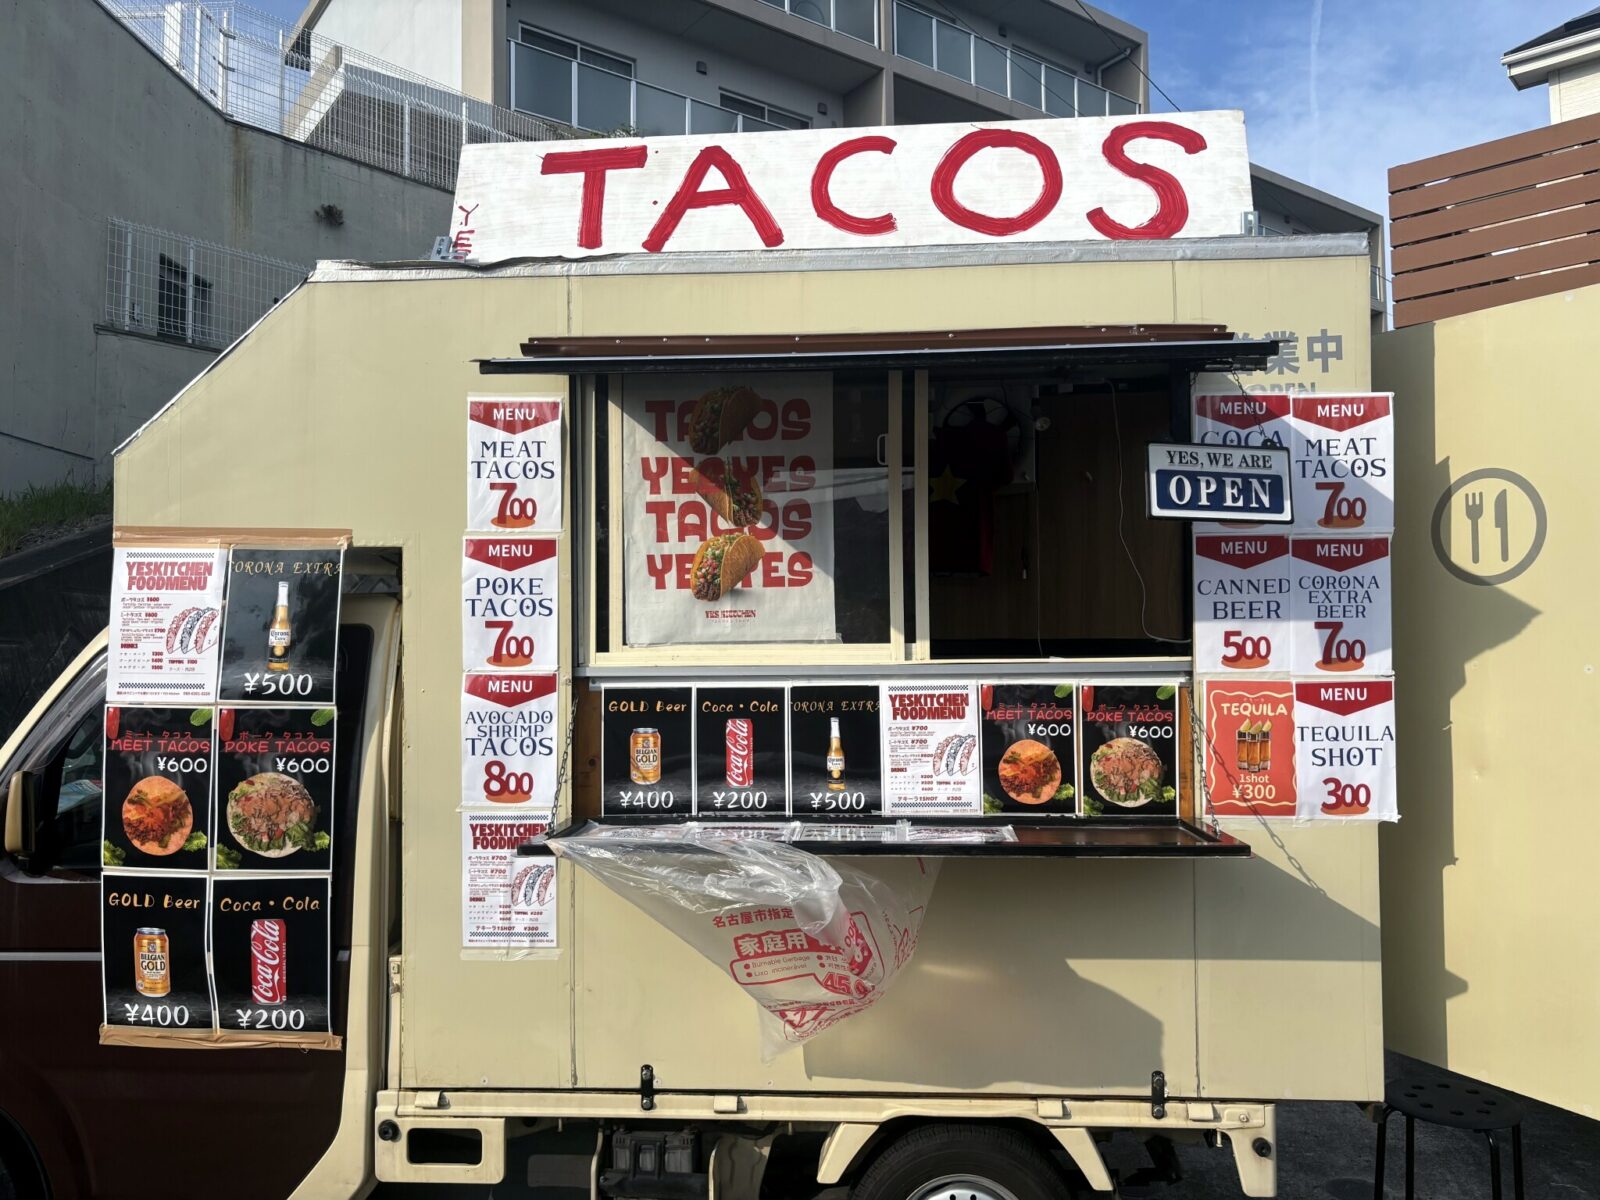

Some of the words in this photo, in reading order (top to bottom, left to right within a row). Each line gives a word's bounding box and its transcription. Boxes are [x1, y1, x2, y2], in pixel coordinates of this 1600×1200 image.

[541, 121, 1207, 253] TACOS
[1233, 328, 1343, 375] 業中
[493, 408, 536, 420] MENU
[1220, 402, 1267, 415] MENU
[1317, 404, 1364, 417] MENU
[480, 441, 546, 458] MEAT
[1305, 437, 1376, 457] MEAT
[1167, 450, 1203, 468] YES,
[1207, 452, 1235, 468] WE
[1238, 454, 1272, 469] ARE
[471, 460, 555, 479] TACOS
[1296, 458, 1386, 479] TACOS
[1168, 474, 1271, 508] OPEN
[490, 482, 537, 524] 700
[1315, 482, 1366, 524] 700
[488, 544, 533, 557] MENU
[1221, 541, 1268, 554] MENU
[1316, 544, 1364, 557] MENU
[126, 561, 213, 576] YESKITCHEN
[232, 561, 284, 575] ORONA
[128, 576, 207, 590] FOODMENU
[476, 577, 543, 595] POKE
[1198, 578, 1290, 595] CANNED
[1299, 575, 1380, 590] CORONA
[1308, 590, 1372, 604] EXTRA
[465, 598, 553, 617] TACOS
[1213, 600, 1281, 620] BEER
[1317, 605, 1366, 618] BEER
[485, 620, 534, 663] 700
[1222, 630, 1271, 663] 500
[1314, 621, 1366, 665] 700
[244, 673, 312, 695] ¥500
[488, 680, 533, 693] MENU
[888, 693, 969, 707] YESKITCHEN
[1320, 688, 1367, 701] MENU
[608, 701, 649, 712] GOLD
[656, 700, 687, 712] Beer
[702, 701, 733, 713] Coca
[750, 700, 778, 712] Cola
[790, 701, 833, 713] ORONA
[893, 707, 965, 720] FOODMENU
[1221, 703, 1288, 716] TEQUILA
[465, 711, 553, 724] AVOCADO
[986, 710, 1023, 720] MEET
[1028, 710, 1072, 720] TACOS
[1087, 712, 1123, 722] POKE
[1128, 712, 1173, 722] TACOS
[125, 730, 152, 739] ミート
[477, 725, 544, 737] SHRIMP
[1027, 723, 1071, 736] ¥600
[1129, 726, 1173, 738] ¥600
[1297, 726, 1394, 742] TEQUILA
[111, 740, 153, 752] MEET
[158, 740, 210, 752] TACOS
[224, 741, 268, 753] POKE
[276, 741, 331, 753] TACOS
[465, 737, 553, 756] TACOS
[636, 755, 657, 763] GOLD
[1312, 747, 1382, 766] SHOT
[157, 757, 208, 773] ¥600
[276, 757, 329, 773] ¥600
[484, 760, 534, 796] 800
[1239, 773, 1269, 783] 1shot
[619, 791, 674, 808] ¥400
[713, 791, 768, 809] ¥200
[1232, 784, 1276, 800] ¥300
[1321, 777, 1371, 810] 300
[810, 792, 865, 810] ¥500
[108, 892, 155, 908] GOLD
[163, 894, 200, 909] Beer
[220, 897, 261, 911] Coca
[282, 896, 320, 911] Cola
[712, 908, 795, 928] 名古屋市指定
[738, 932, 808, 956] 家庭用
[140, 960, 166, 971] GOLD
[124, 1003, 190, 1026] ¥400
[236, 1008, 305, 1030] ¥200
